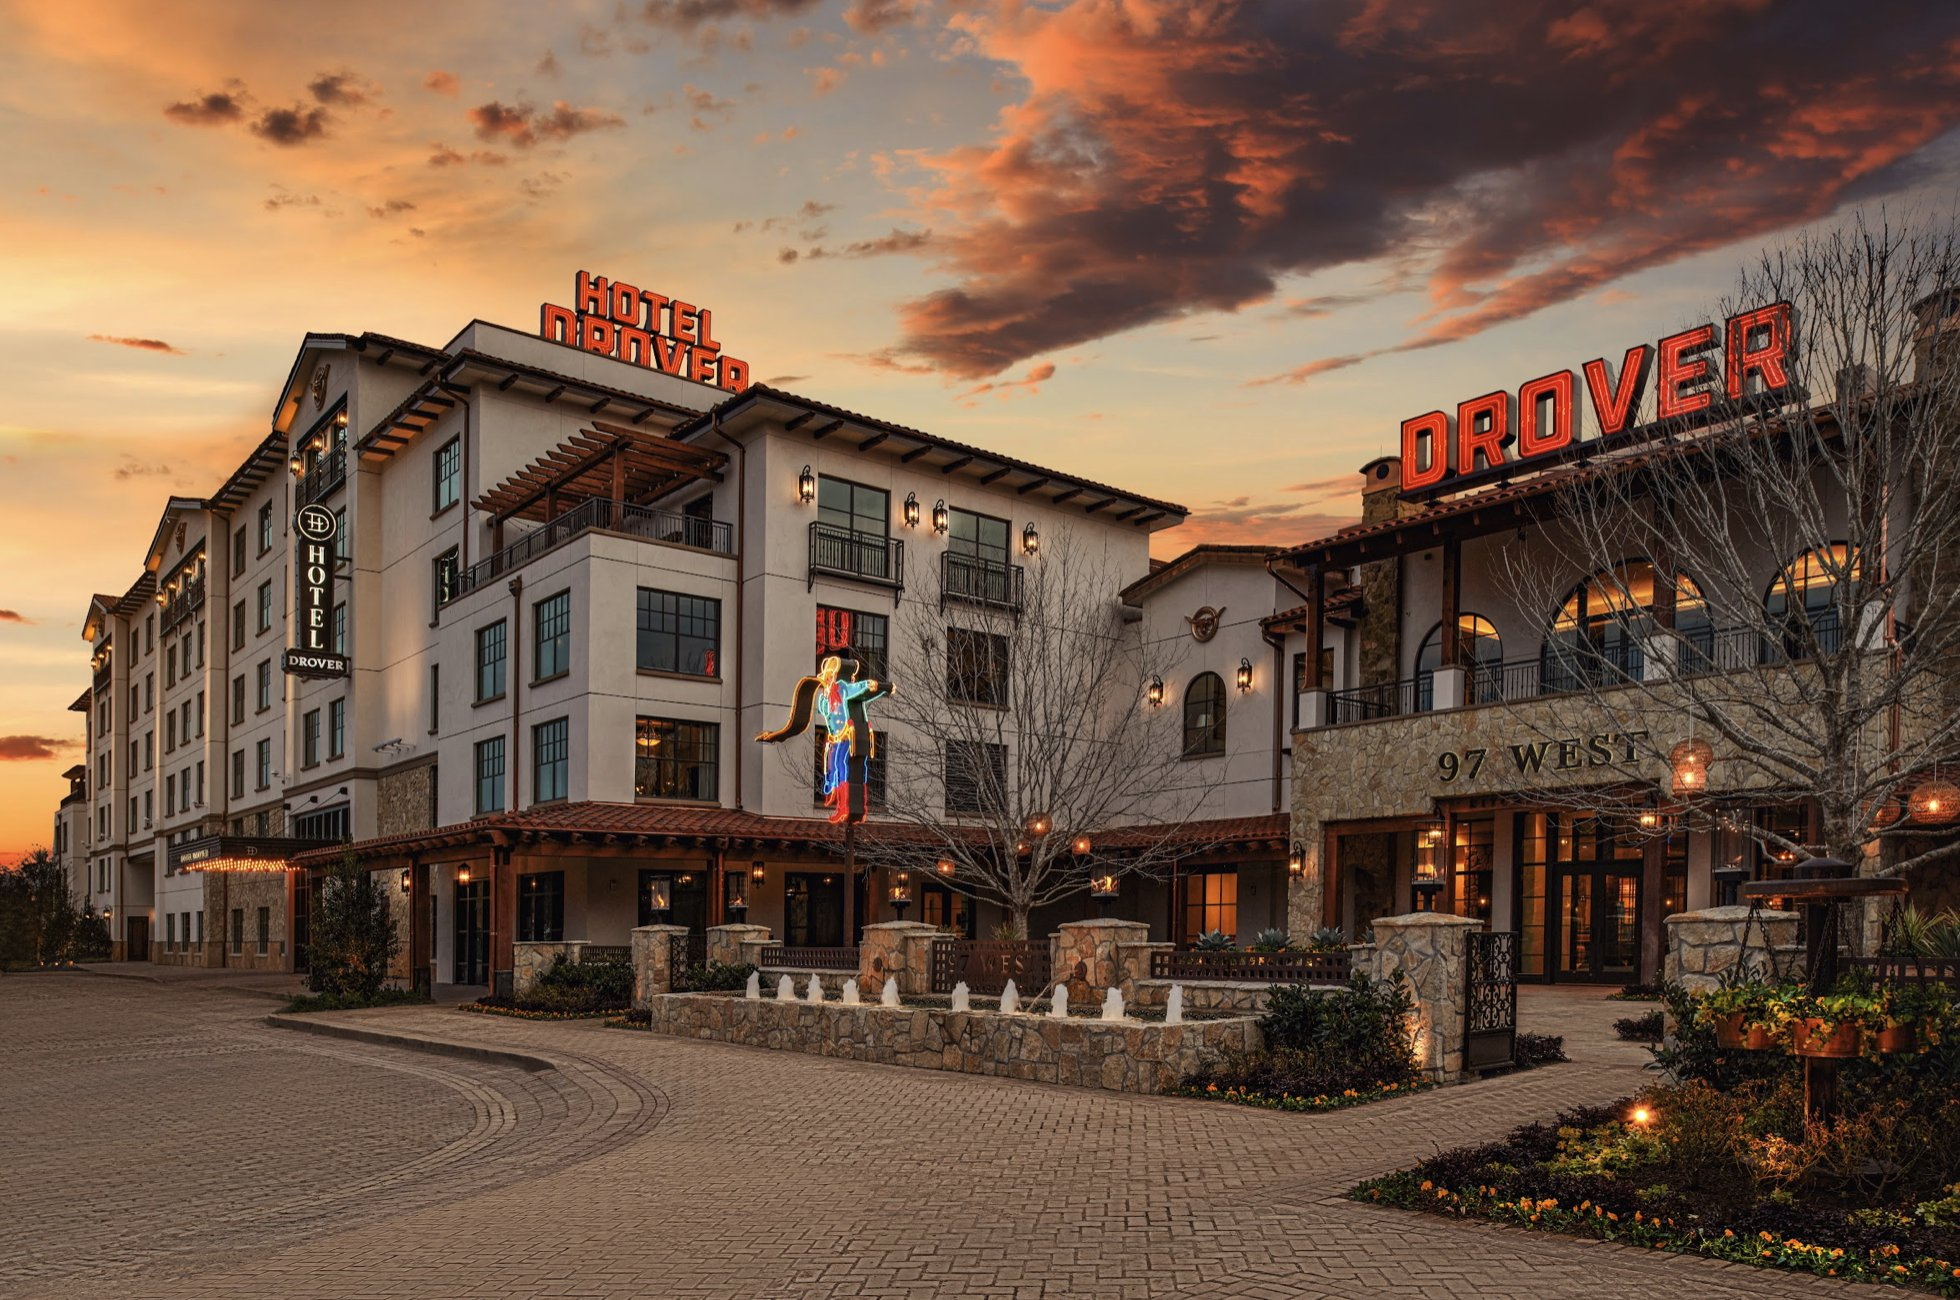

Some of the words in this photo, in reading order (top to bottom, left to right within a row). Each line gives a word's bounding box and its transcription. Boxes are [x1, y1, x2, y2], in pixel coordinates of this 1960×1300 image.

[541, 303, 749, 394] DROVER
[576, 270, 721, 351] HOTEL
[1401, 300, 1799, 492] DROVER
[308, 544, 326, 649] HOTEL
[288, 655, 344, 671] DROVER
[1438, 749, 1487, 782] 97
[1507, 730, 1650, 775] WEST
[979, 952, 1033, 976] WES
